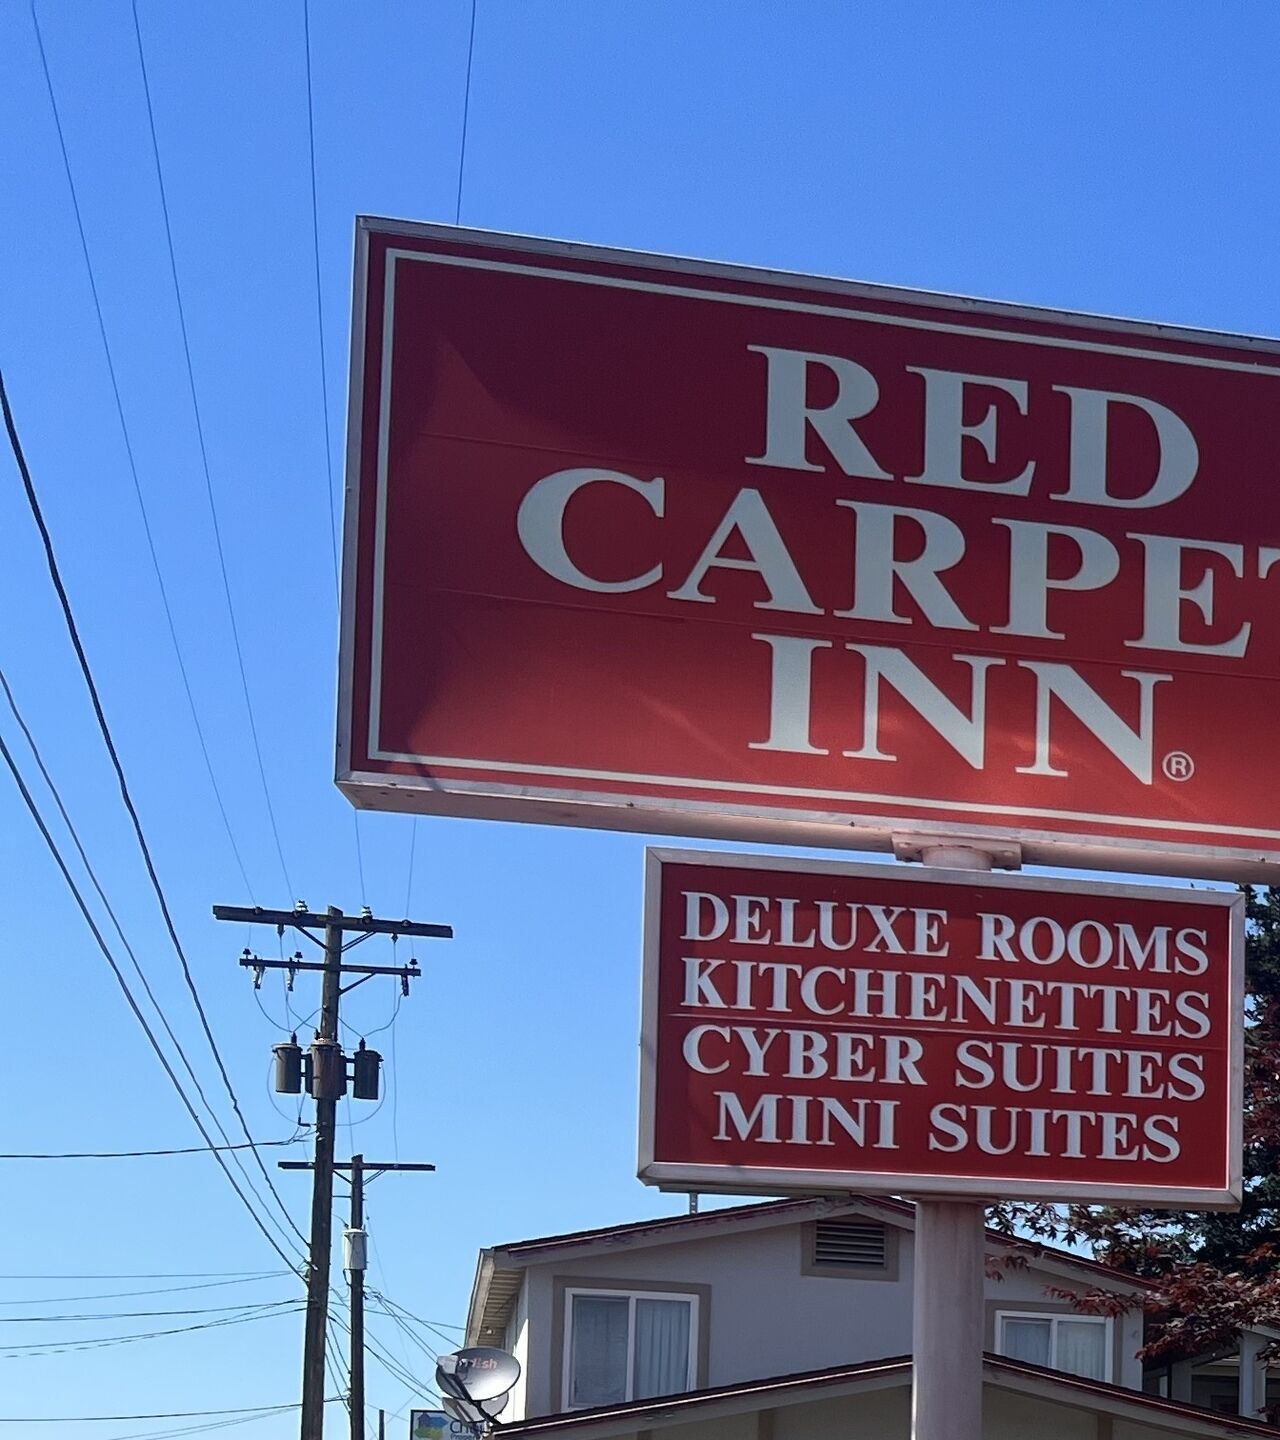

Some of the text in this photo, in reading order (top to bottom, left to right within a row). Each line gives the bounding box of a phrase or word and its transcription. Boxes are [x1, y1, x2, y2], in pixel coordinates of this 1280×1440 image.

[745, 344, 1200, 509] RED
[746, 633, 1174, 786] INN
[680, 891, 1209, 976] DELUXE ROOMS
[680, 957, 1211, 1040] KITCHENETTES
[682, 1024, 1206, 1101] CYBER SUITES
[712, 1091, 1182, 1164] MINI SUITES
